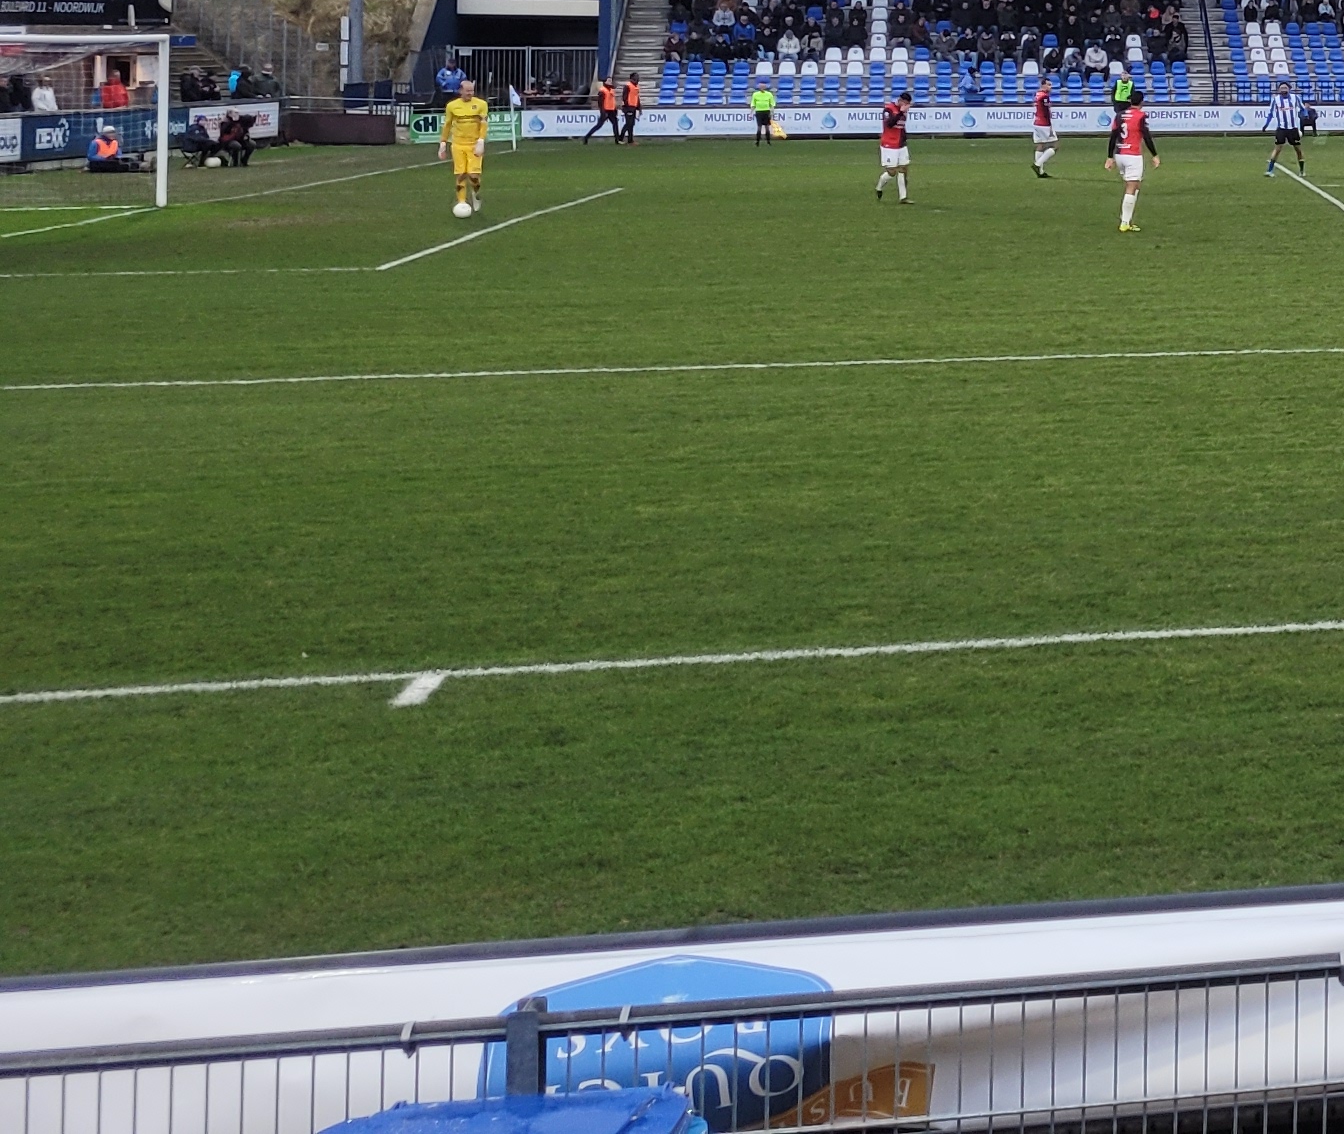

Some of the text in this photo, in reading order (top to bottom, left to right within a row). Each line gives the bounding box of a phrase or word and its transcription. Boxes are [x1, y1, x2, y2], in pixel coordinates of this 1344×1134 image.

[53, 2, 105, 14] NOORDWIJK
[649, 114, 667, 123] DM
[794, 112, 811, 121] DM
[934, 111, 954, 120] DM
[1071, 111, 1087, 120] DM
[1203, 110, 1220, 119] DM
[1121, 123, 1129, 139] 3
